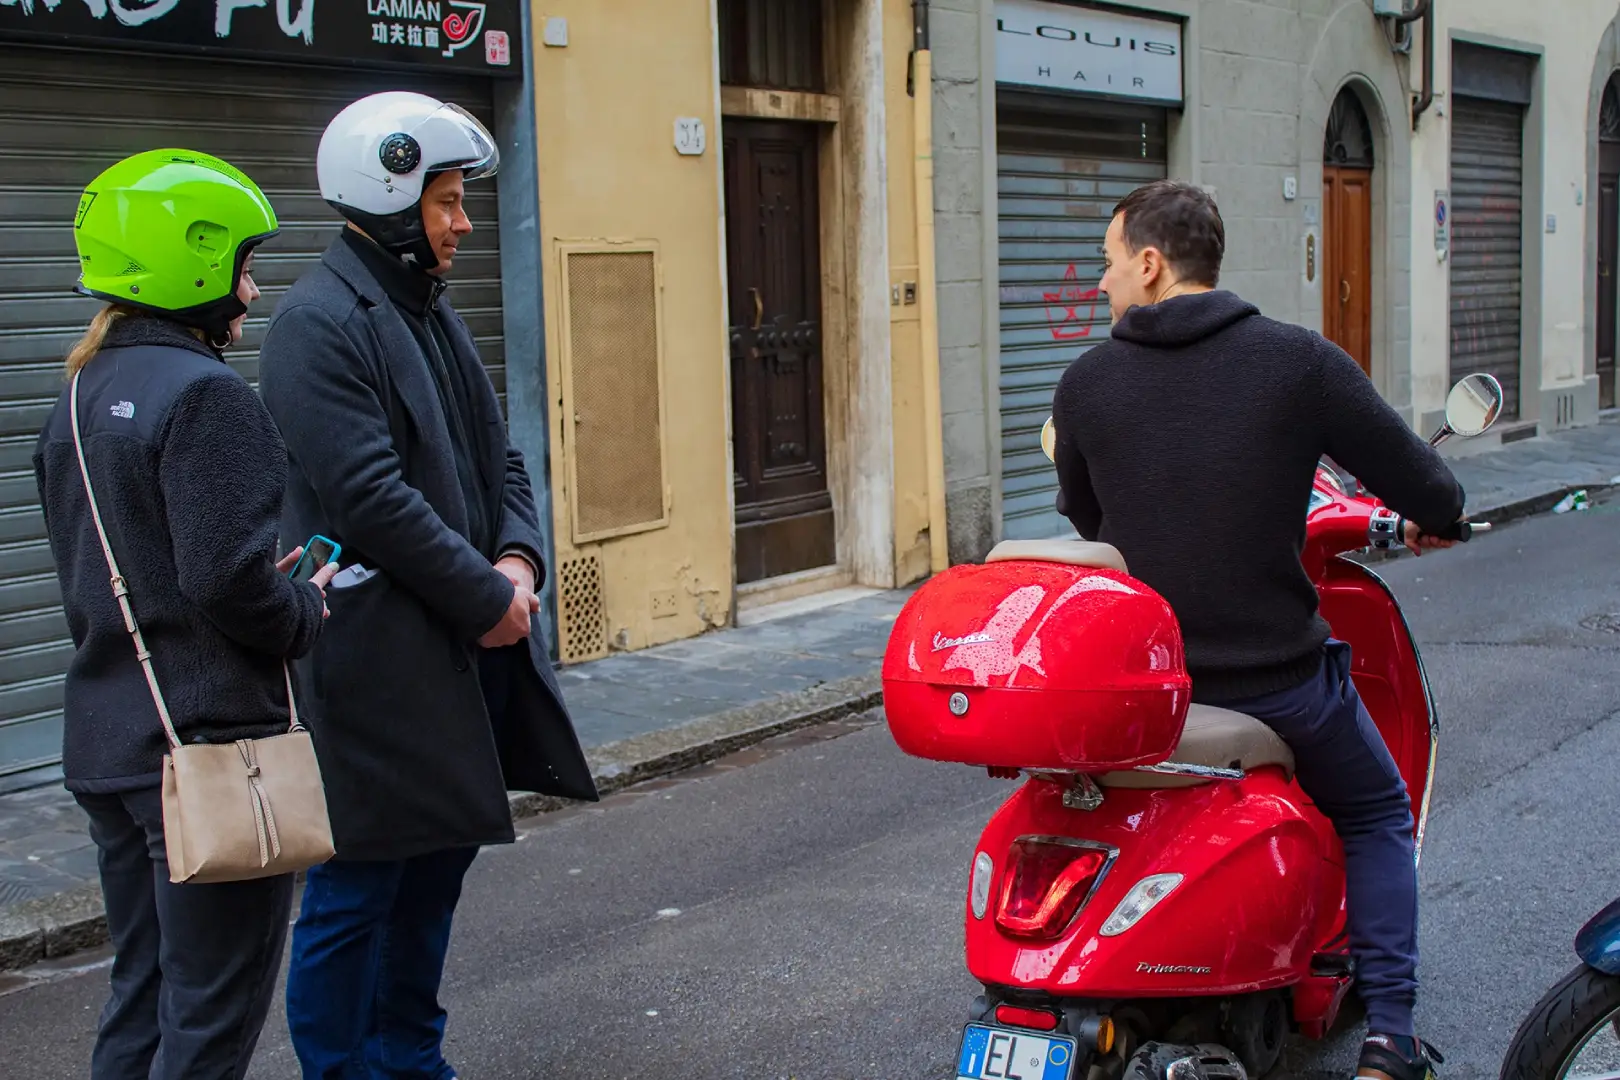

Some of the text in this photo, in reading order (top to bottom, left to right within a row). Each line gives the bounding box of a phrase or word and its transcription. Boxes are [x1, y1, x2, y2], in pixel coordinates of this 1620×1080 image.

[367, 0, 440, 21] LAMIAN
[371, 21, 440, 48] 功夫拉面
[997, 19, 1176, 56] LOUIS
[1038, 66, 1144, 88] HAIR
[1136, 961, 1212, 974] Primavera
